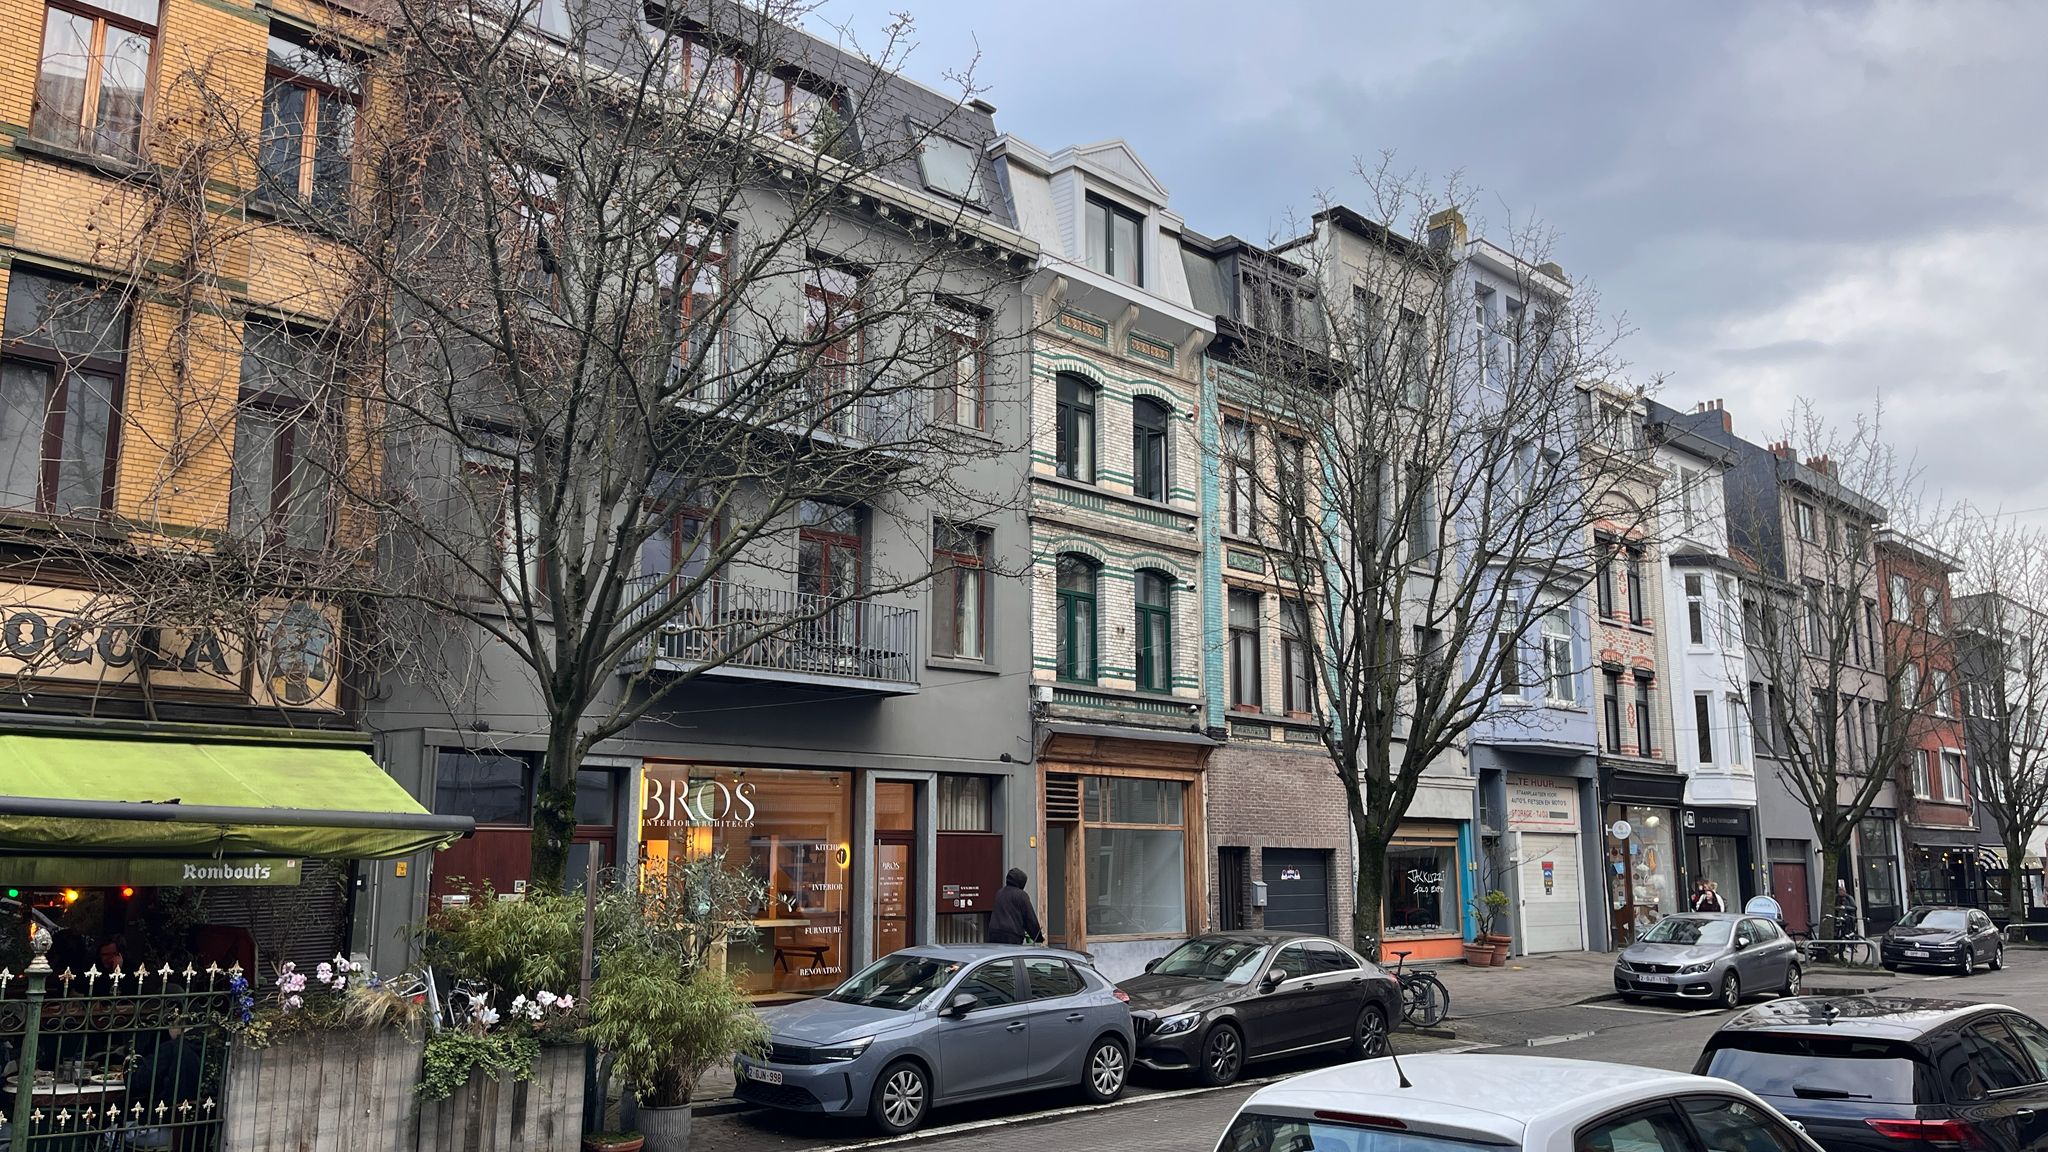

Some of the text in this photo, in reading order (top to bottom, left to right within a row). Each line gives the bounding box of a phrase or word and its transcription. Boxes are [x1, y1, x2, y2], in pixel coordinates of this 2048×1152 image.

[1518, 777, 1554, 788] TE HUUR
[642, 777, 756, 822] BROS
[1527, 798, 1544, 806] FIETSEN
[642, 819, 755, 828] INTERIOR ARCHITECTS
[183, 863, 271, 880] Rombouts
[812, 883, 843, 891] INTERIOR
[804, 926, 843, 935] FURNITURE
[799, 966, 842, 977] RENOVATION
